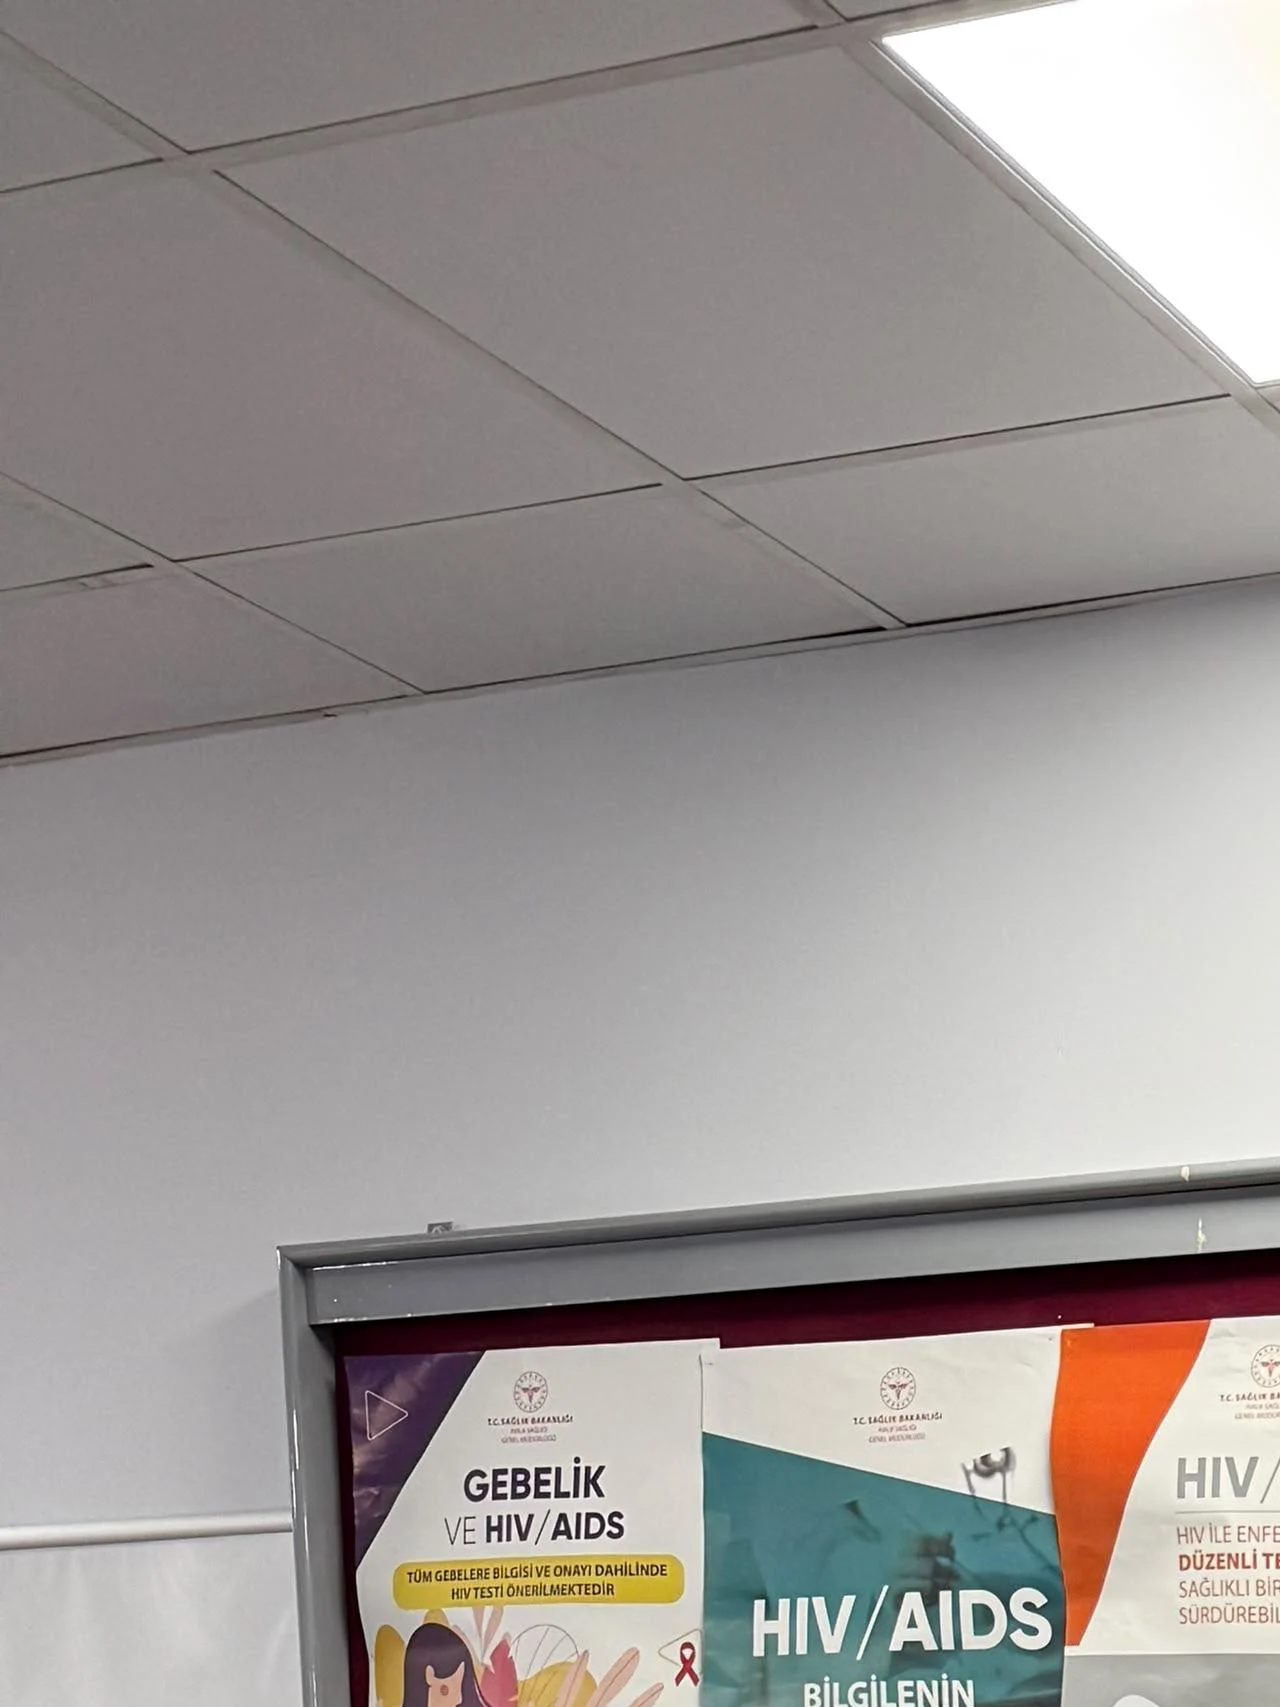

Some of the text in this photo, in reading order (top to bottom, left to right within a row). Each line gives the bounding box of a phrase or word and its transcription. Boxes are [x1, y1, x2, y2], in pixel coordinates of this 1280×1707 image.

[464, 1457, 606, 1502] GEBELİK
[444, 1509, 625, 1545] VE HIV/AIDS
[1177, 1526, 1203, 1545] HIV
[1209, 1522, 1232, 1543] İLE
[1178, 1550, 1258, 1571] DÜZENLİ
[407, 1561, 668, 1584] TÜM GEBELERE BİLGİSİ VE ONAYI DAHİLİNDE
[451, 1581, 615, 1600] HIV TESTİ ÖNERİLMEKTEDİR
[1178, 1577, 1250, 1598] SAĞLIKLI
[752, 1584, 1053, 1661] HIV/AIDS
